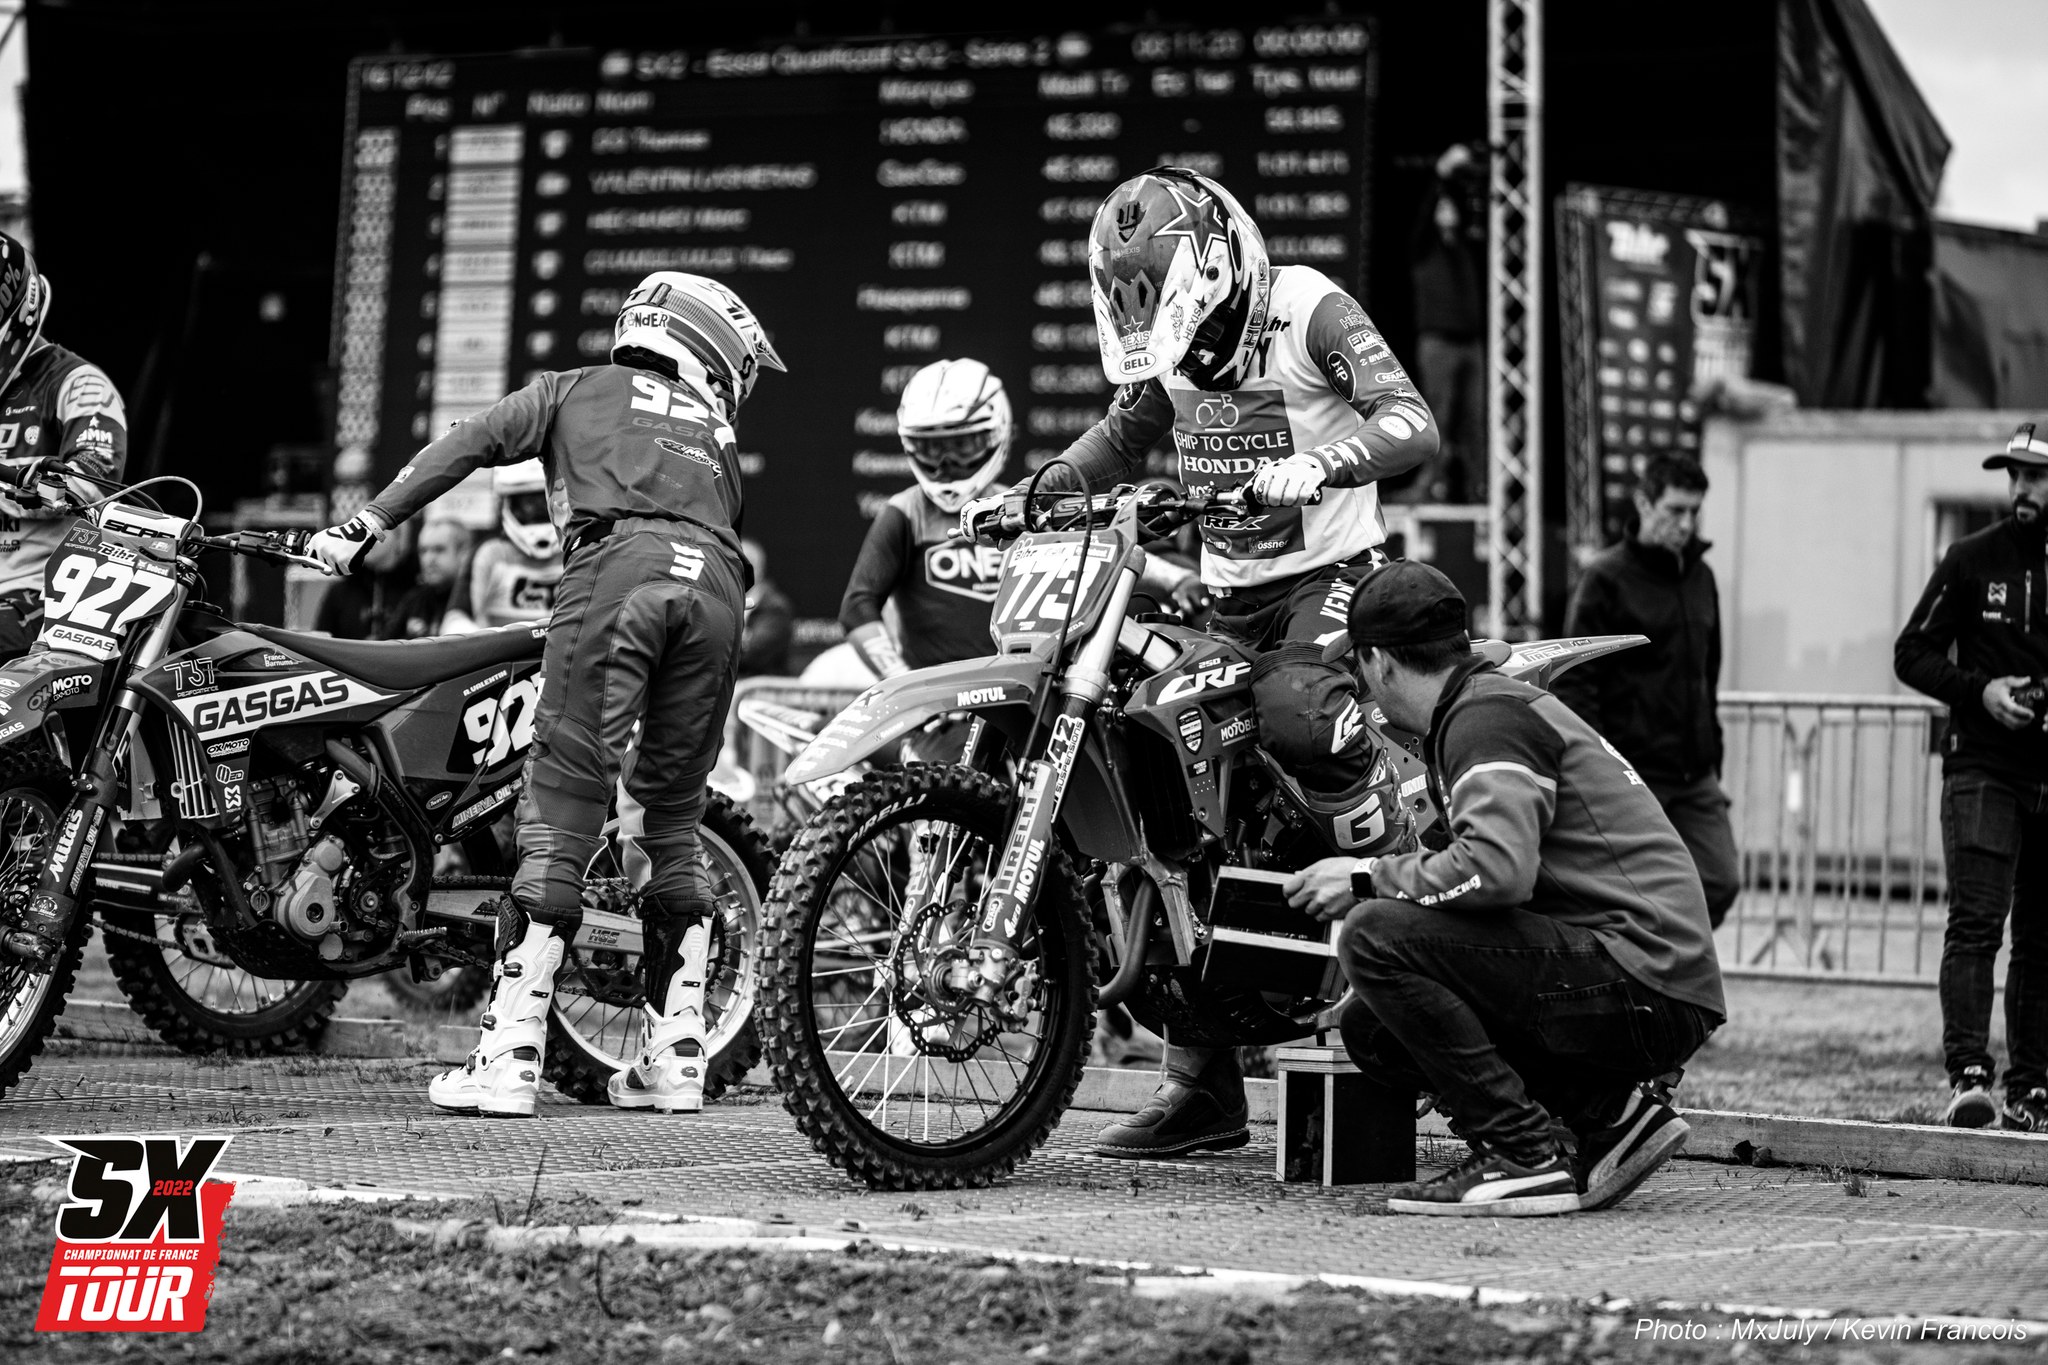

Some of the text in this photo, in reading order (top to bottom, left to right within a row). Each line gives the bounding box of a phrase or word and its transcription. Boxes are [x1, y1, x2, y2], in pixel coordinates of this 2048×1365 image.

[1242, 257, 1269, 350] HEXIS
[1121, 331, 1151, 346] HEXIS
[1183, 307, 1203, 342] HEXIS
[1124, 357, 1151, 370] BELL
[1177, 431, 1289, 451] SHIP TO CYCLE
[1183, 455, 1273, 474] HONDA
[0, 514, 21, 532] ki
[70, 527, 100, 545] 737
[1203, 515, 1271, 531] RFX
[100, 542, 136, 561] Bihr
[44, 554, 177, 636] 927
[997, 559, 1102, 624] 773
[1319, 580, 1357, 625] KENN
[52, 628, 115, 651] GASGAS
[163, 657, 217, 691] 737
[1156, 661, 1252, 706] CRF
[177, 685, 219, 698] PERFORMANCE
[193, 675, 350, 733] GASGAS
[957, 687, 1006, 706] MOTUL
[1221, 717, 1257, 741] MOTOBL
[1055, 721, 1083, 793] SUSPENSIONS
[452, 784, 512, 829] MINERVA OIL
[847, 794, 927, 851] PIRELLI
[49, 809, 84, 883] Mitas
[69, 843, 92, 896] MINERVA
[85, 824, 99, 846] OIL
[1013, 839, 1046, 905] MOTUL
